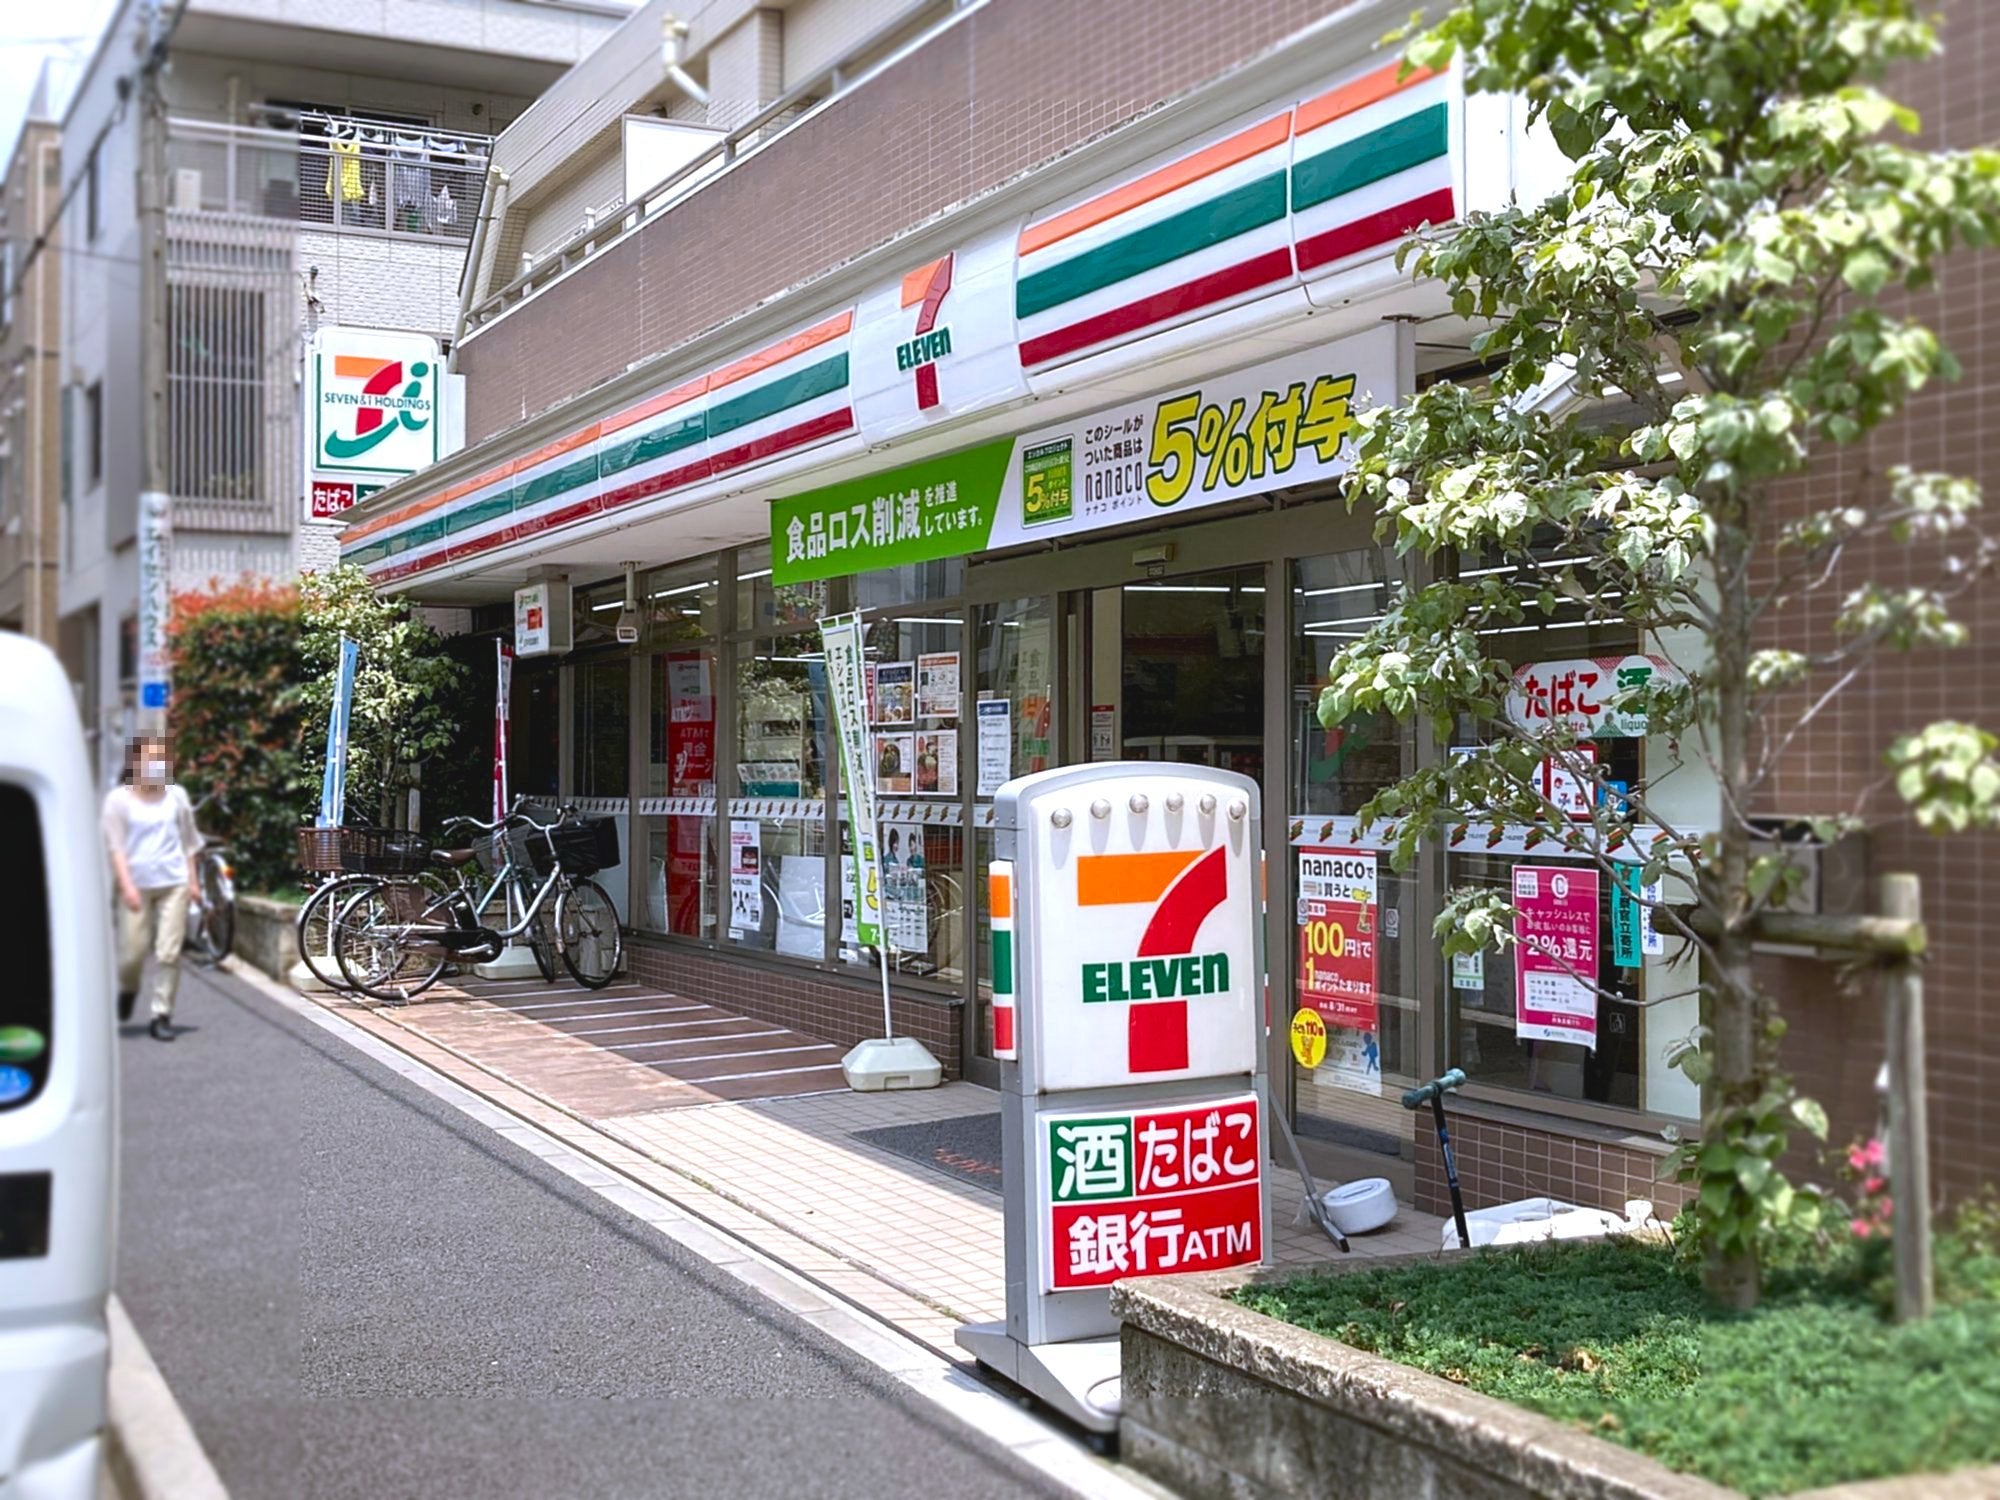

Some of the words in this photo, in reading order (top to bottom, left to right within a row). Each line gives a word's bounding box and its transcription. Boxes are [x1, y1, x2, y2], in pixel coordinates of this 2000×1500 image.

[375, 395, 431, 411] HOLDINGS
[1085, 415, 1144, 445] このシールが
[1145, 373, 1357, 507] 5%付与
[1085, 438, 1143, 466] ついた商品は
[924, 480, 958, 508] を推進
[1085, 461, 1143, 503] nanaco
[314, 487, 352, 512] たばこ
[786, 488, 921, 565] 食品ロス削減
[924, 505, 983, 537] しています。
[1525, 669, 1600, 719] たばこ
[1620, 718, 1649, 732] liquo
[1302, 858, 1374, 879] nanacoで
[1526, 906, 1591, 923] キャッシュレスで
[1526, 933, 1593, 962] 2%還元
[1057, 1124, 1128, 1199] 酒
[1138, 1110, 1256, 1191] たばこ
[1068, 1208, 1185, 1276] 銀行
[1182, 1221, 1252, 1264] ATM
